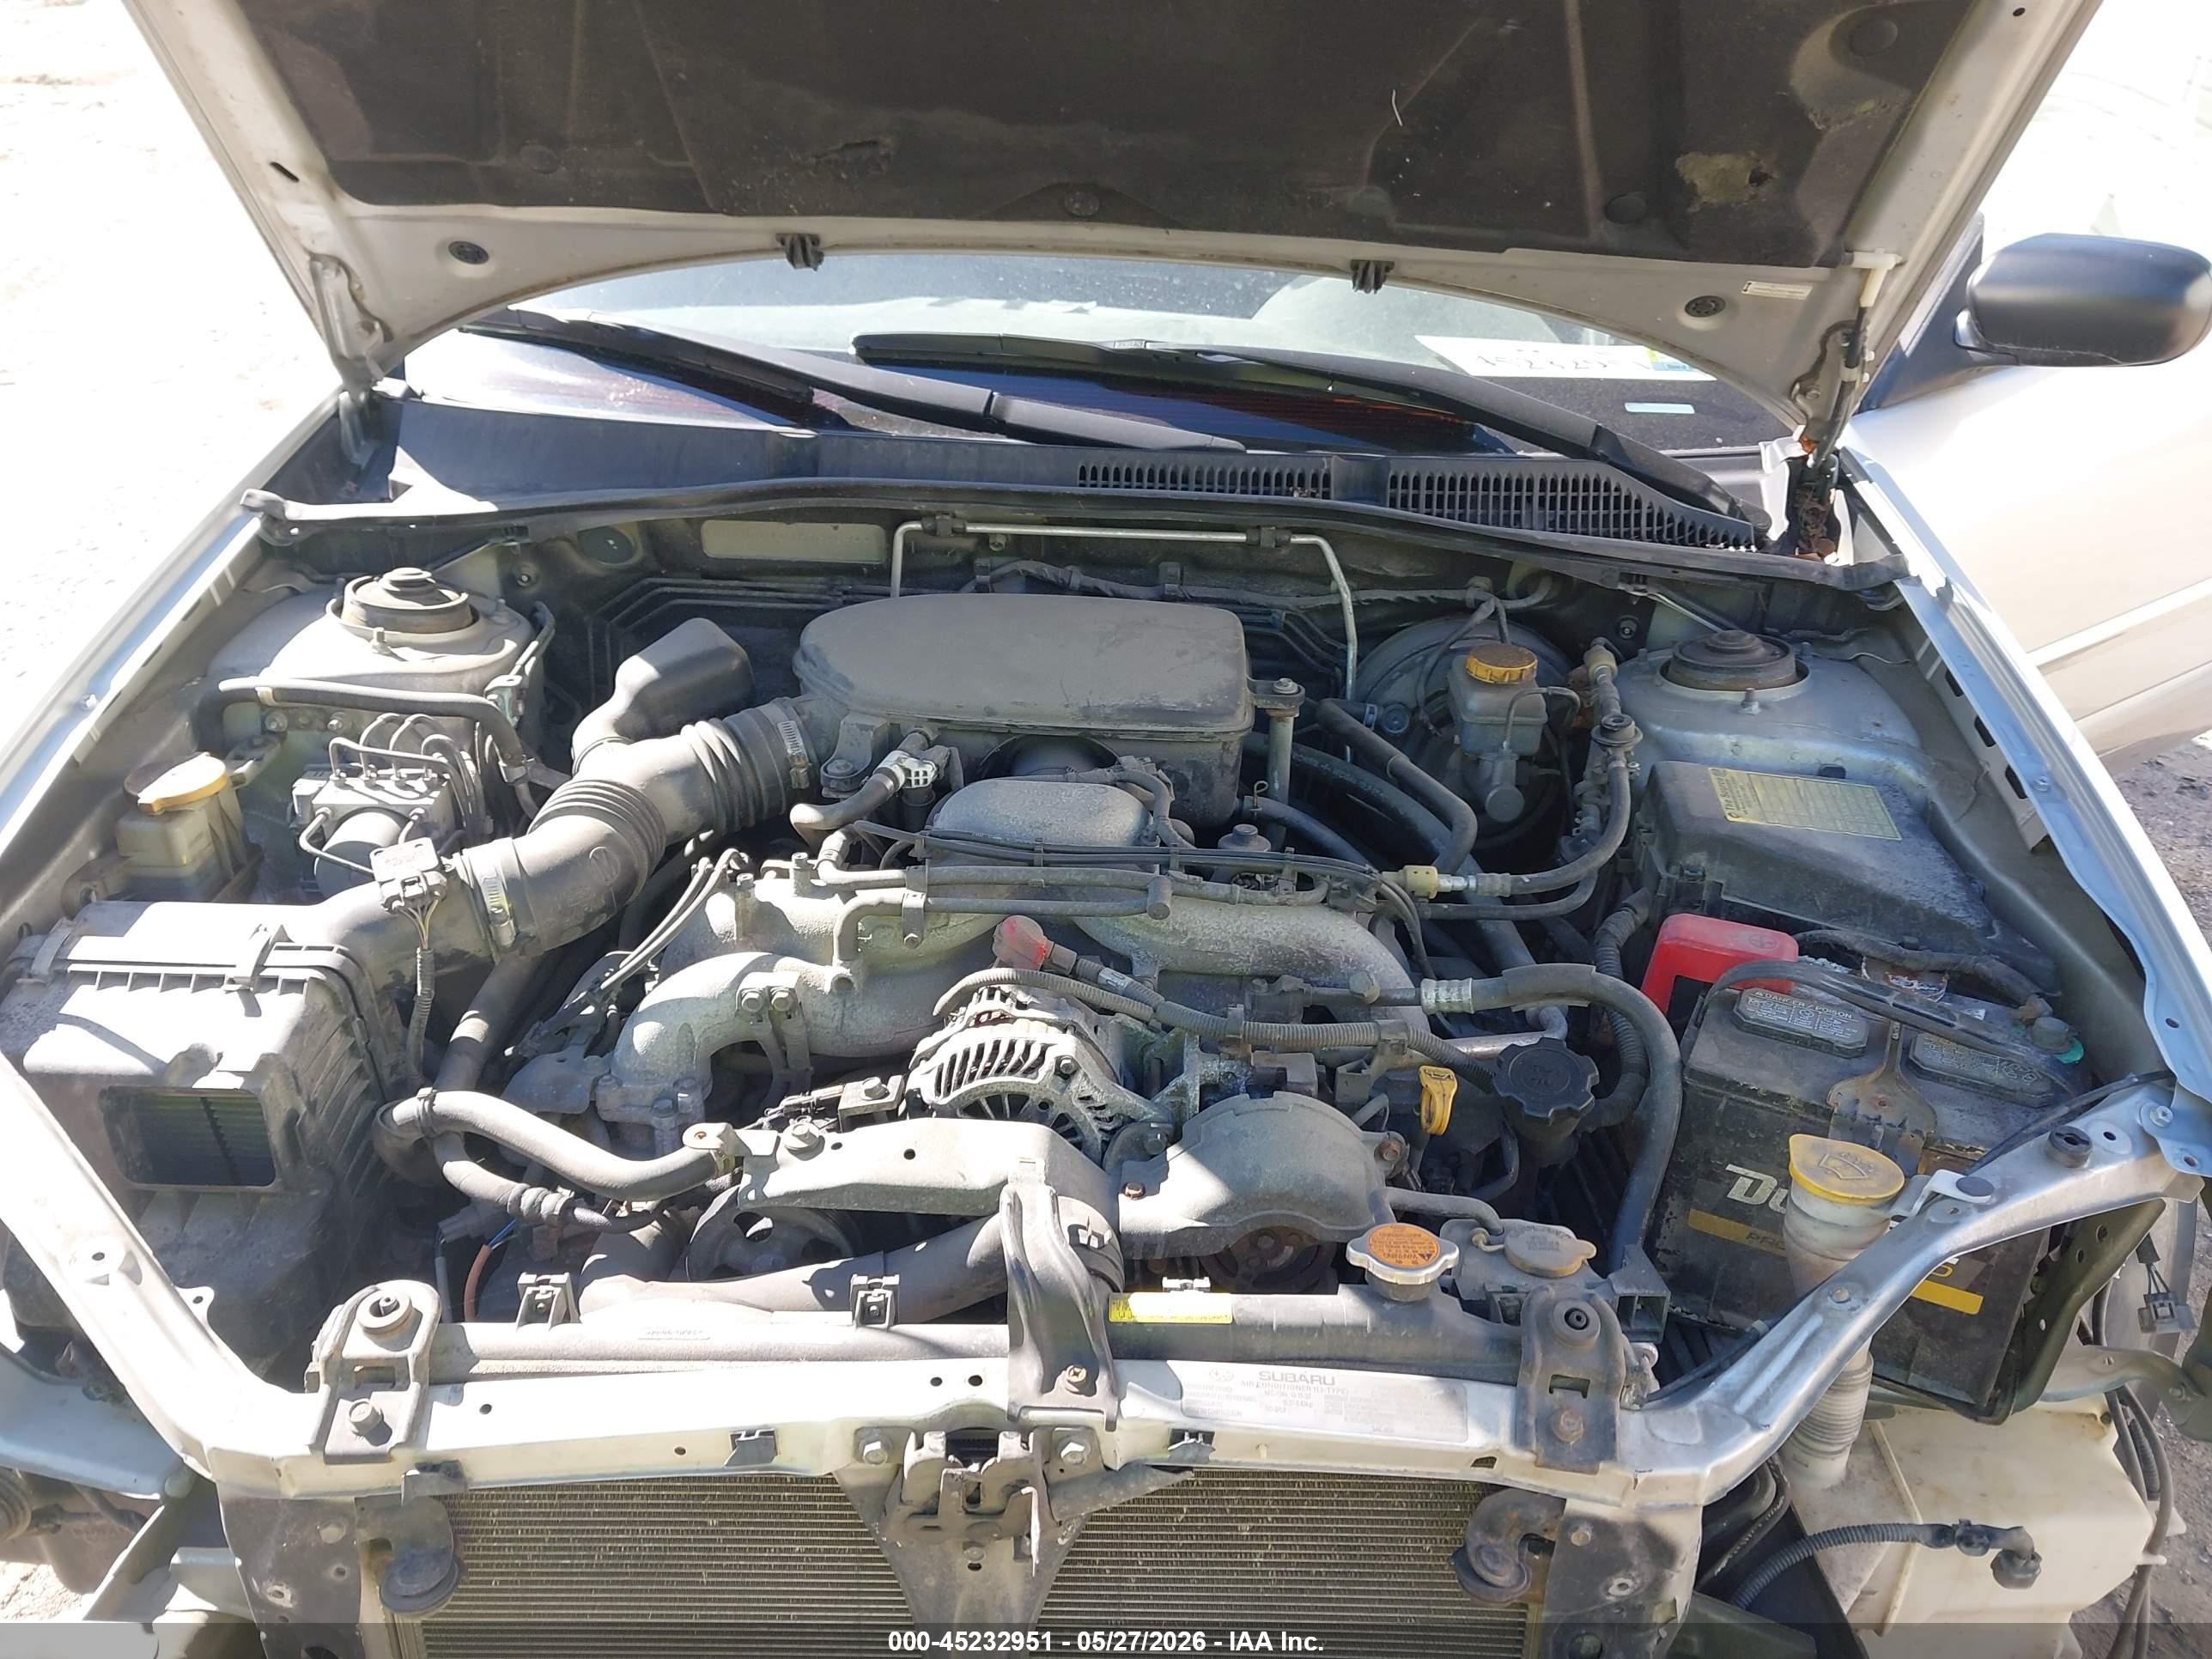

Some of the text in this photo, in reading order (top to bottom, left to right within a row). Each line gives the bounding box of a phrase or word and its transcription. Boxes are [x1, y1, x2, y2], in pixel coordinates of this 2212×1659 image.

[1765, 993, 1806, 1007] DANGER
[1814, 1006, 1853, 1019] POISON
[1258, 1370, 1336, 1386] SUBARU
